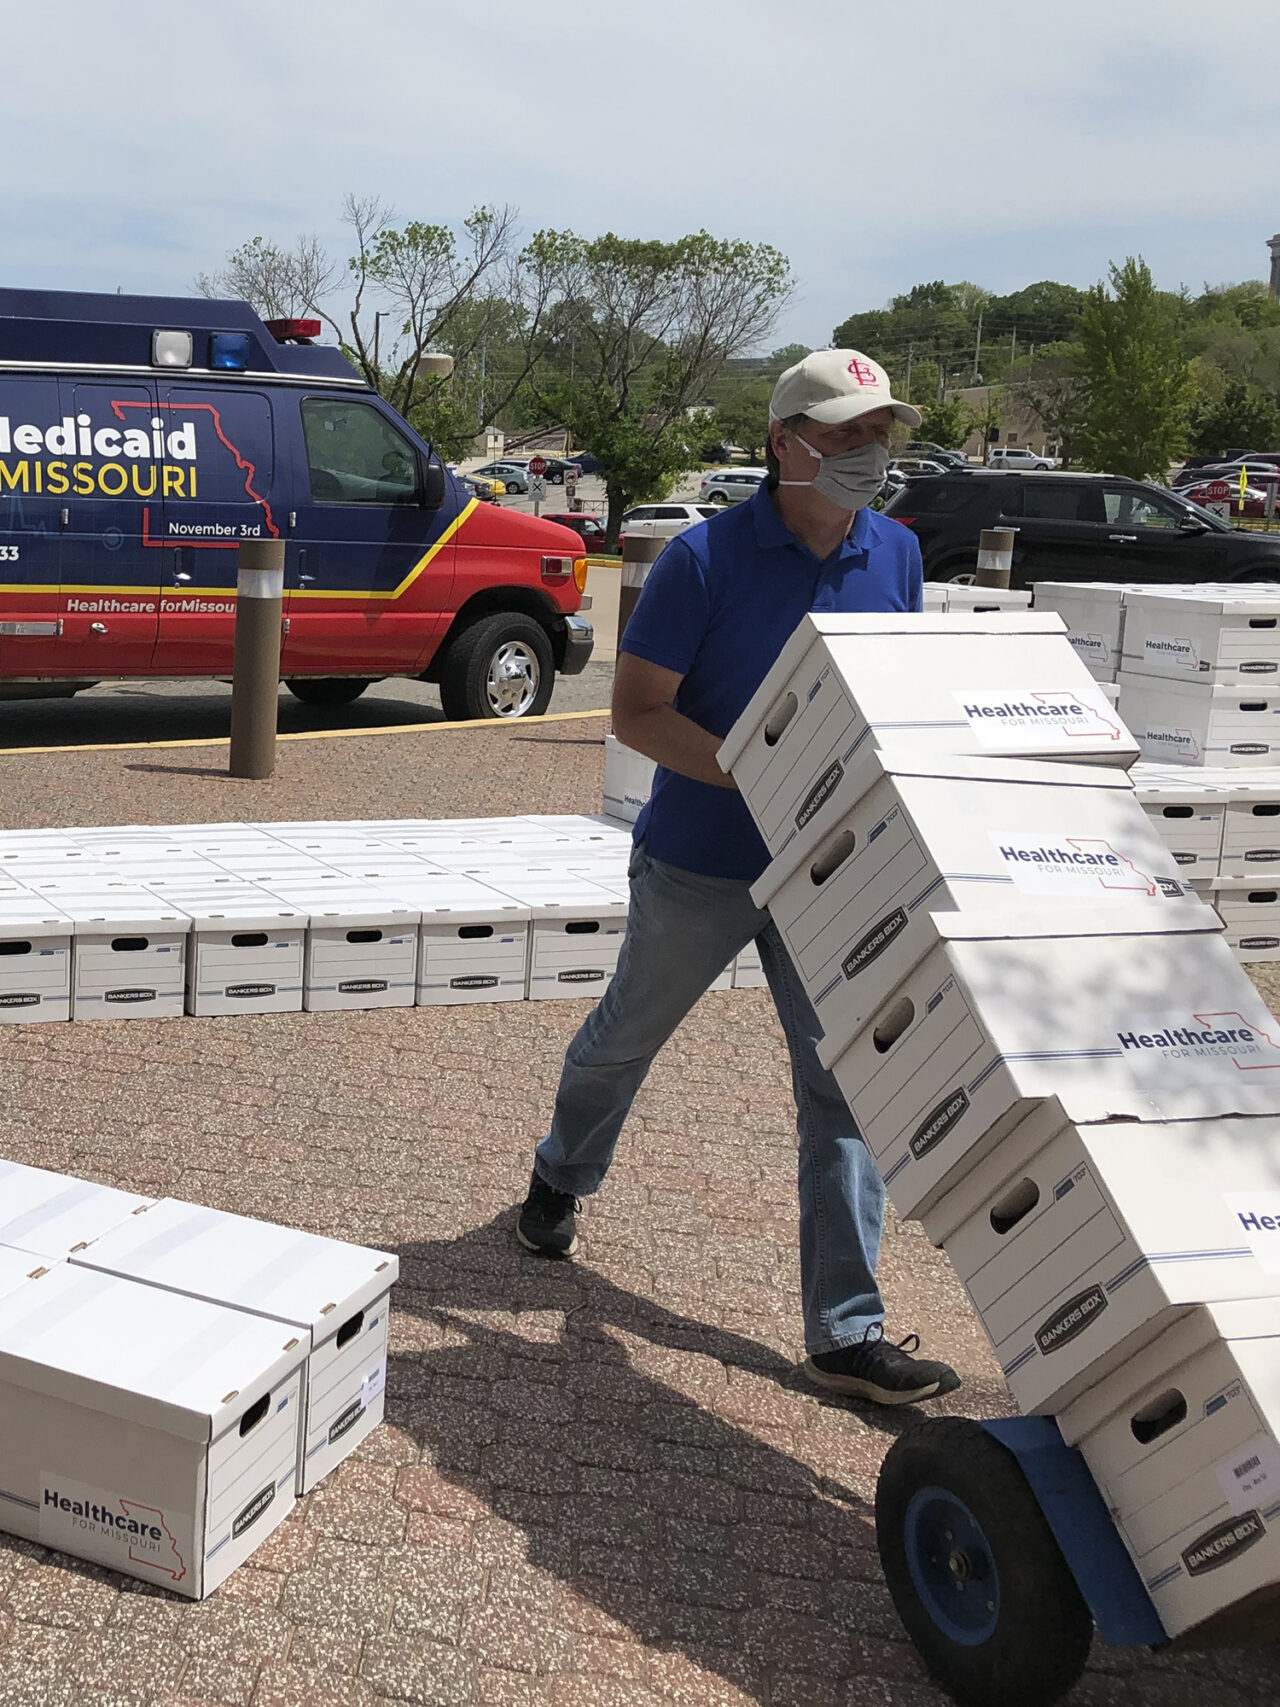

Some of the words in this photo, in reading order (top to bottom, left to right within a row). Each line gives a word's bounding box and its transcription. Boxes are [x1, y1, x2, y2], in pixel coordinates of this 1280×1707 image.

[530, 462, 546, 470] STOP
[1208, 486, 1229, 495] STOP
[169, 523, 237, 536] November
[240, 524, 260, 536] 3rd
[67, 599, 155, 613] Healthcare
[1145, 640, 1190, 653] Healthcare
[963, 703, 1083, 718] Healthcare
[1147, 731, 1191, 744] Healthcare
[798, 783, 827, 827] BANKERS
[826, 766, 841, 791] BOX
[999, 846, 1119, 866] Healthcare
[846, 930, 886, 972] BANKERS
[883, 914, 904, 936] BOX
[1117, 1028, 1255, 1049] Healthcare
[913, 1113, 949, 1153] BANKERS
[946, 1095, 966, 1120] BOX
[1040, 1306, 1083, 1348] BANKERS
[1080, 1293, 1103, 1314] BOX
[330, 1410, 355, 1438] BANKERS
[44, 1488, 162, 1541] Healthcare
[233, 1502, 261, 1534] BANKERS
[260, 1489, 275, 1509] BOX
[1187, 1529, 1236, 1569] BANKERS
[1233, 1517, 1260, 1543] BOX
